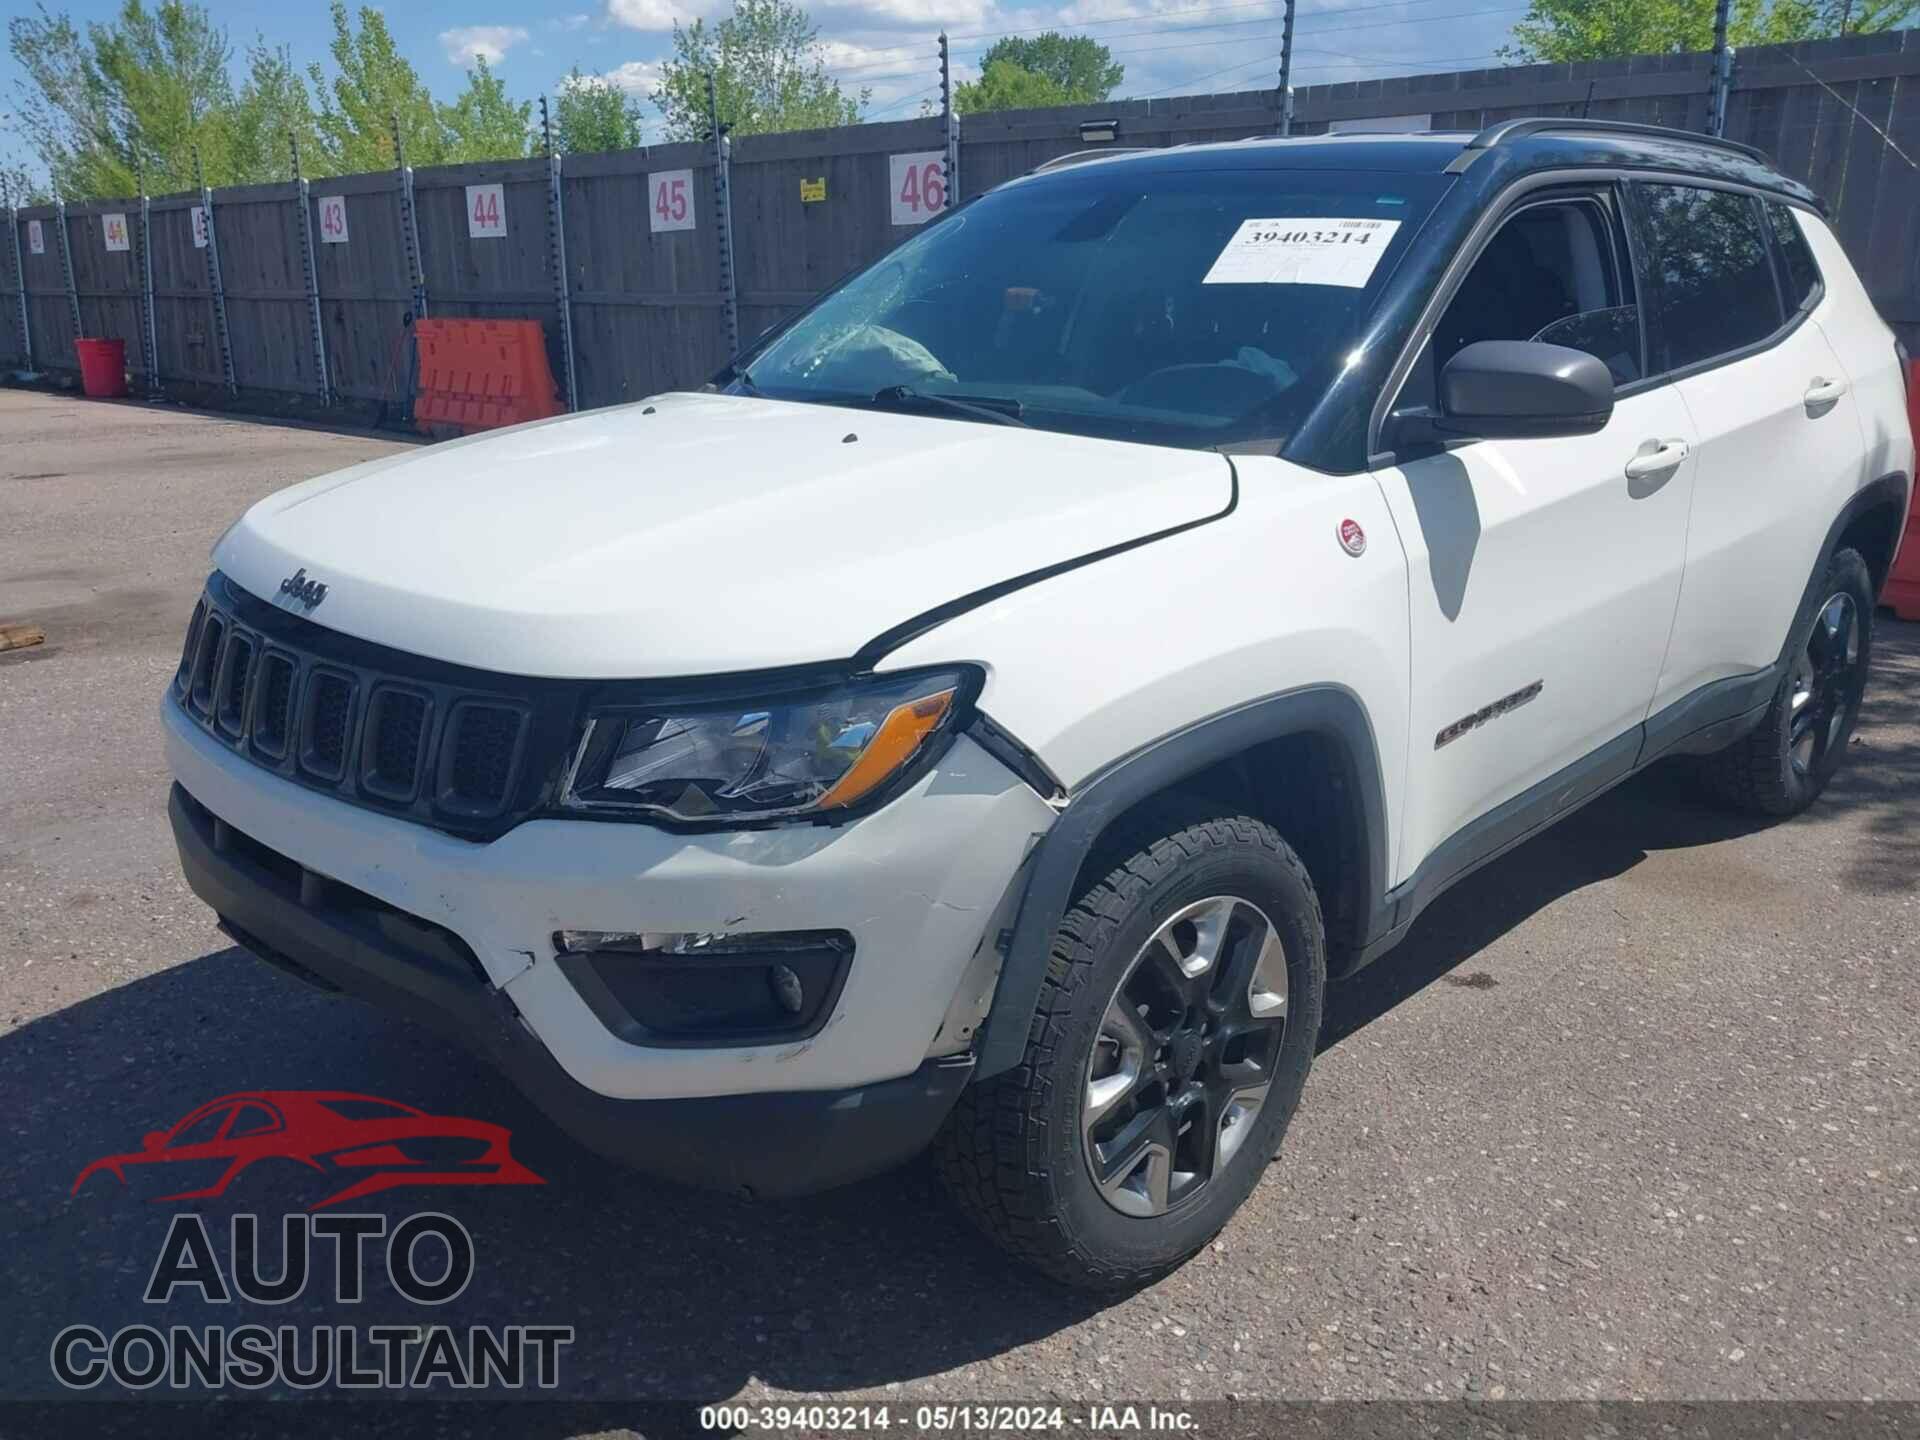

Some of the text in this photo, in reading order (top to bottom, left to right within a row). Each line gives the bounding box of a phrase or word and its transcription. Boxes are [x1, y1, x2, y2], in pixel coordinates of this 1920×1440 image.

[655, 179, 686, 222] 45
[900, 162, 944, 213] 46
[324, 203, 344, 236] 43
[473, 192, 500, 229] 44
[1245, 231, 1372, 245] 39403214
[281, 567, 329, 611] Jeep
